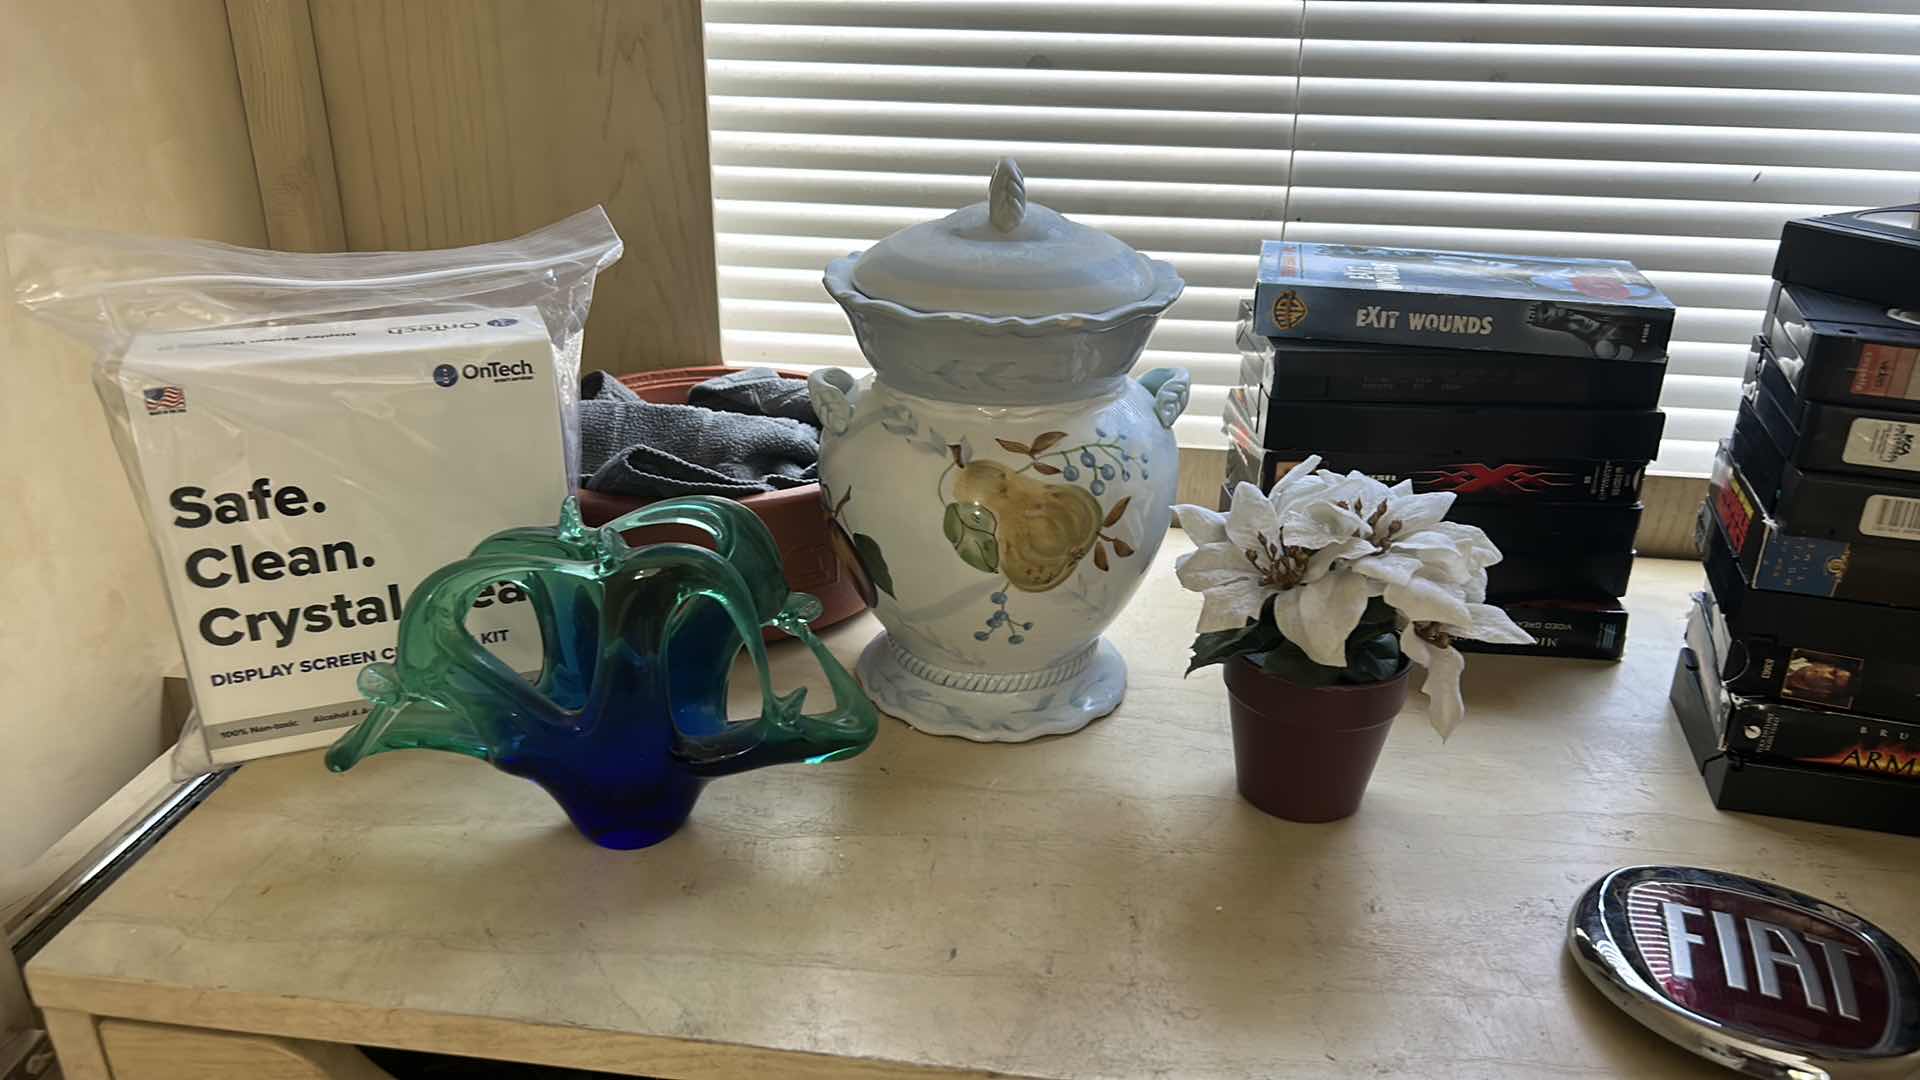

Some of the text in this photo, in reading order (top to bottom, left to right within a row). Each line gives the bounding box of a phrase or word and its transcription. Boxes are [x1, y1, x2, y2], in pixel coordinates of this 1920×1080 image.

[1355, 305, 1494, 335] EXIT WOUNDS
[463, 359, 533, 379] OnTech
[169, 478, 326, 528] Safe.
[185, 539, 375, 588] Clean.
[199, 584, 401, 648] Crystal
[210, 661, 295, 687] DISPLAY
[300, 649, 377, 674] SCREEN
[480, 629, 509, 645] KIT
[221, 727, 248, 739] 100%
[1840, 750, 1918, 776] ARM
[1662, 901, 1862, 1022] FIAT
